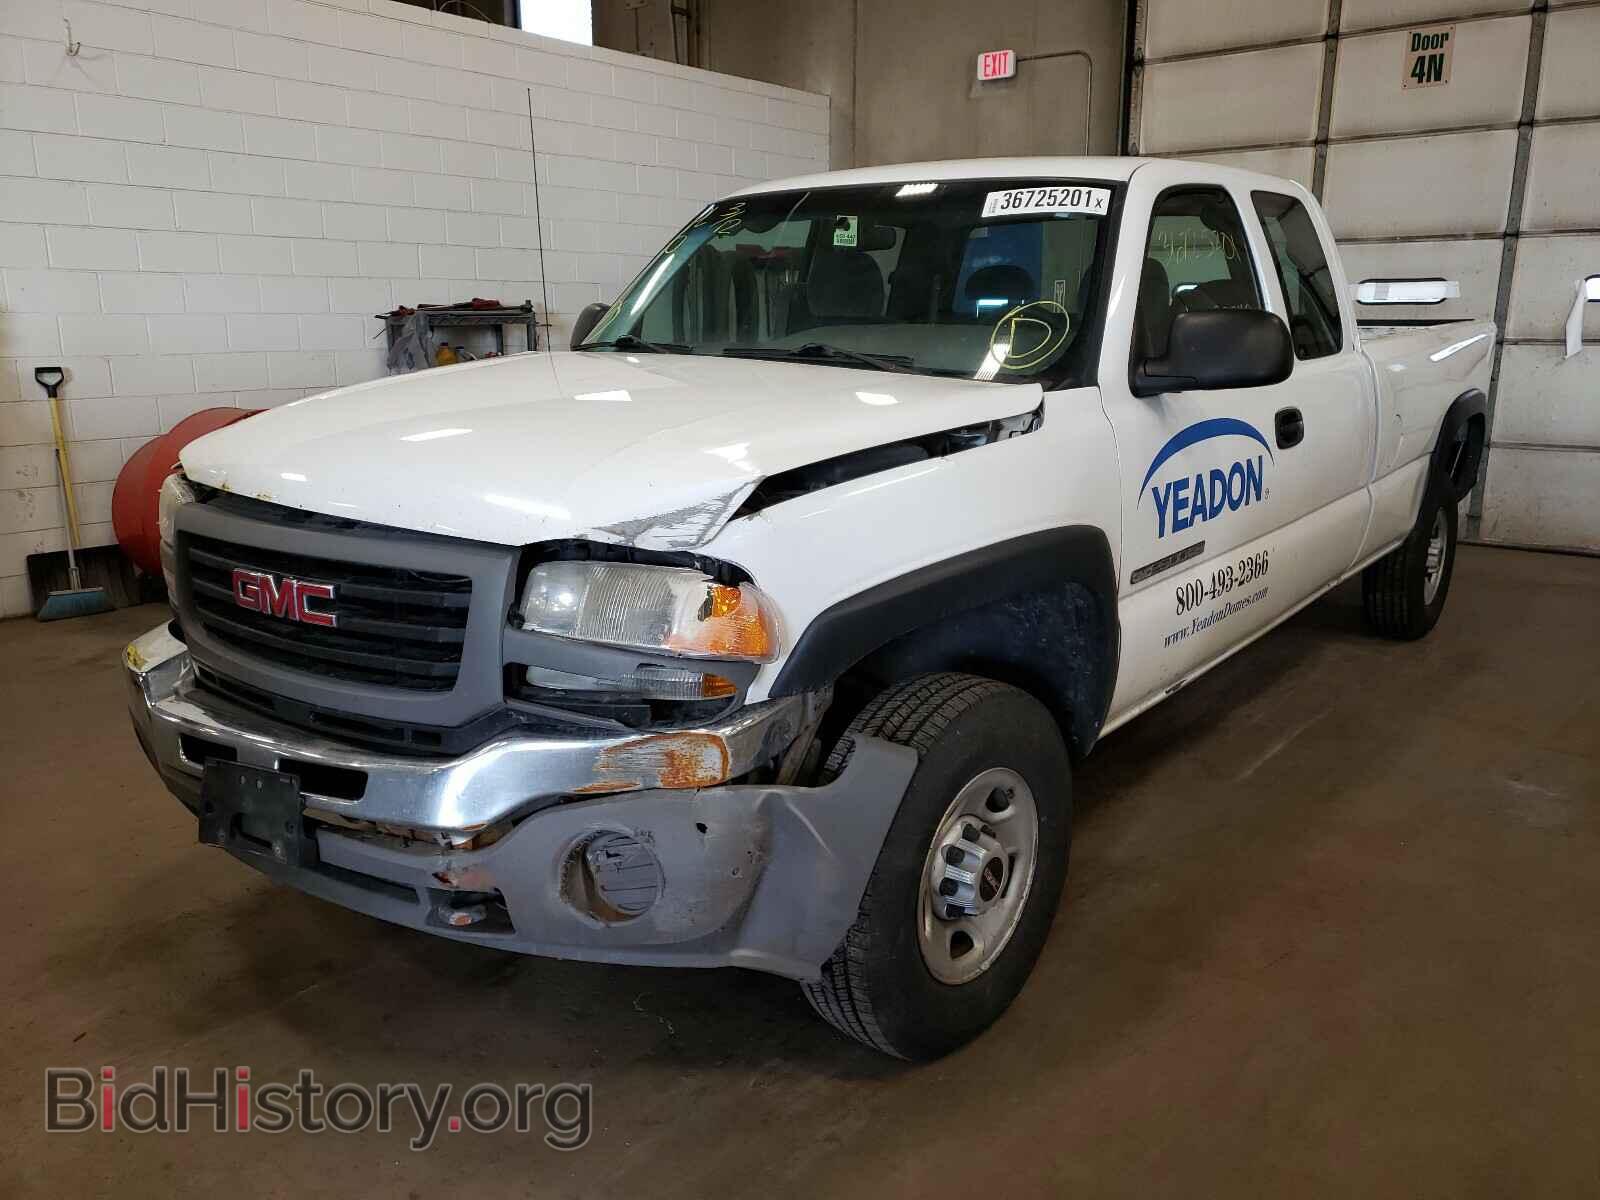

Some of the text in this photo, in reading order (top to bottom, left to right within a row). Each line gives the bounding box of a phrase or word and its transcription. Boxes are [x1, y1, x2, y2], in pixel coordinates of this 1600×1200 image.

[1411, 32, 1449, 51] Door
[984, 52, 1008, 77] EXIT
[1411, 53, 1444, 83] 4N
[1000, 189, 1092, 210] 36725201
[1151, 455, 1263, 539] YEADON
[232, 567, 337, 628] GMC
[1176, 550, 1268, 616] 800-493-2366
